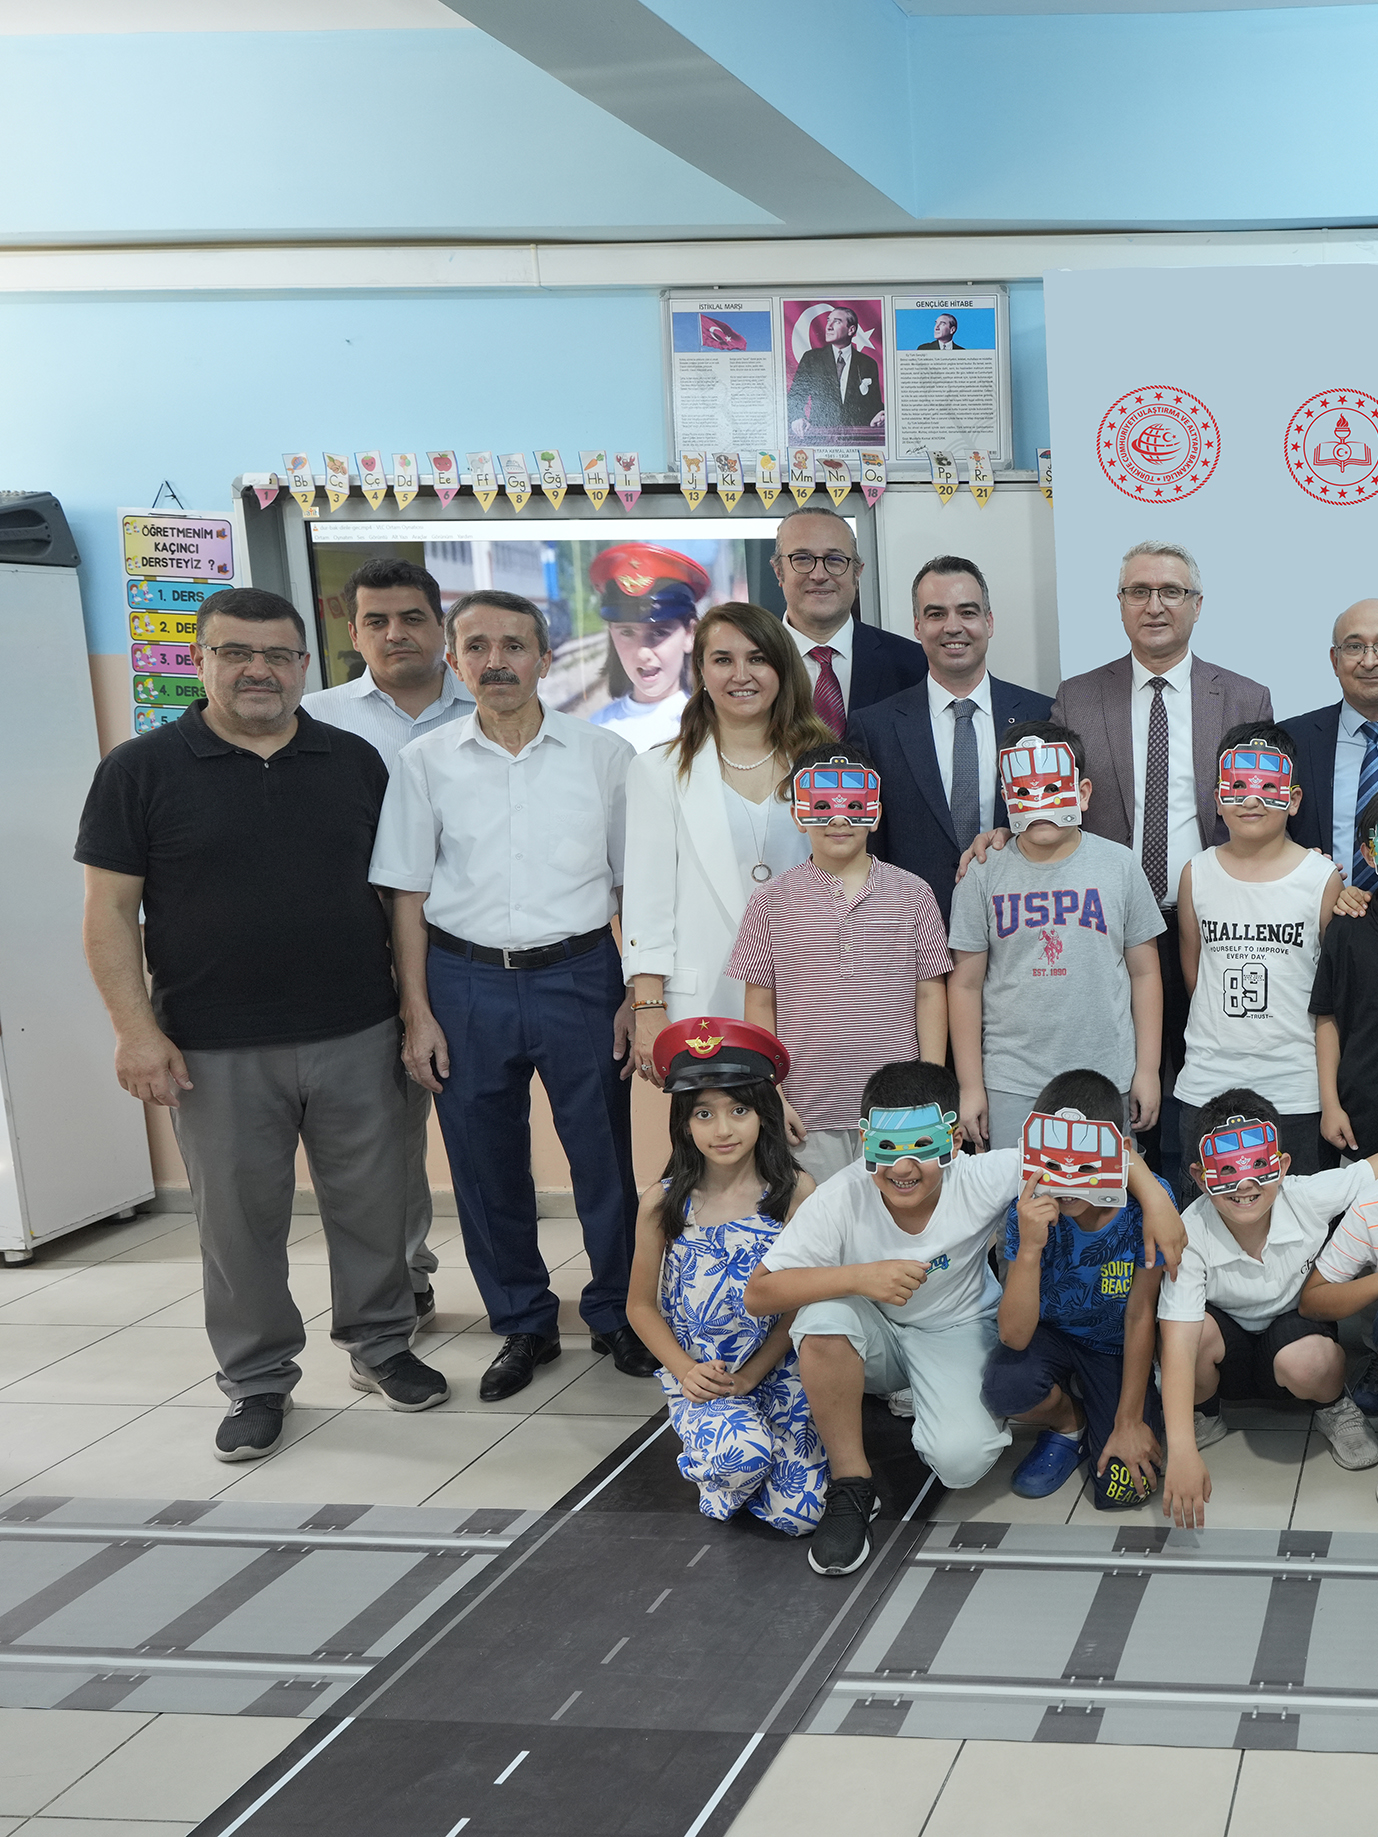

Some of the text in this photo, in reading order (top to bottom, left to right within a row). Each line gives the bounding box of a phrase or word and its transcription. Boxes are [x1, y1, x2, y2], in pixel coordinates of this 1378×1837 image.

[950, 299, 973, 307] HİTABE
[1137, 406, 1180, 419] ULAŞTIRMA
[1180, 415, 1191, 425] VE
[1187, 424, 1199, 453] ALTYAPI
[294, 475, 308, 487] Bb
[329, 474, 344, 488] Cc
[397, 474, 412, 487] Dd
[438, 472, 451, 484] Ee
[476, 473, 489, 486] Ff
[543, 468, 562, 489] Ğğ
[587, 472, 604, 485] Hh
[722, 473, 736, 486] Kk
[790, 469, 813, 483] Mm
[828, 469, 846, 482] Nn
[864, 469, 883, 483] Oo
[938, 467, 952, 484] Pp
[974, 469, 988, 481] Rr
[507, 475, 526, 492] Gg
[687, 473, 698, 490] Jj
[264, 491, 269, 500] 1
[443, 491, 450, 500] 6
[552, 490, 559, 500] 9
[592, 491, 603, 500] 10
[688, 491, 699, 501] 13
[763, 490, 774, 500] 15
[796, 488, 808, 498] 16
[833, 488, 844, 498] 17
[867, 488, 878, 498] 18
[938, 485, 953, 495] 20
[976, 488, 988, 498] 21
[1045, 489, 1053, 499] 2
[301, 494, 309, 503] 2
[333, 493, 340, 503] 3
[372, 492, 379, 501] 4
[401, 493, 408, 502] 5
[483, 493, 490, 502] 7
[516, 494, 523, 504] 8
[624, 493, 633, 502] 11
[724, 492, 736, 502] 14
[142, 524, 213, 540] ÖĞRETMENİM
[154, 541, 199, 555] KAÇINCI
[141, 556, 215, 570] DERSTEYİZ ?
[158, 589, 205, 602] 1. DERS
[159, 621, 170, 633] 2.
[160, 653, 170, 666] 3.
[159, 684, 206, 698] 4. DERS
[992, 887, 1108, 939] USPA
[1201, 919, 1305, 949] CHALLENGE
[1256, 946, 1289, 955] IMPROVE
[1032, 968, 1067, 977] EST. 1890
[1223, 962, 1268, 1018] 89
